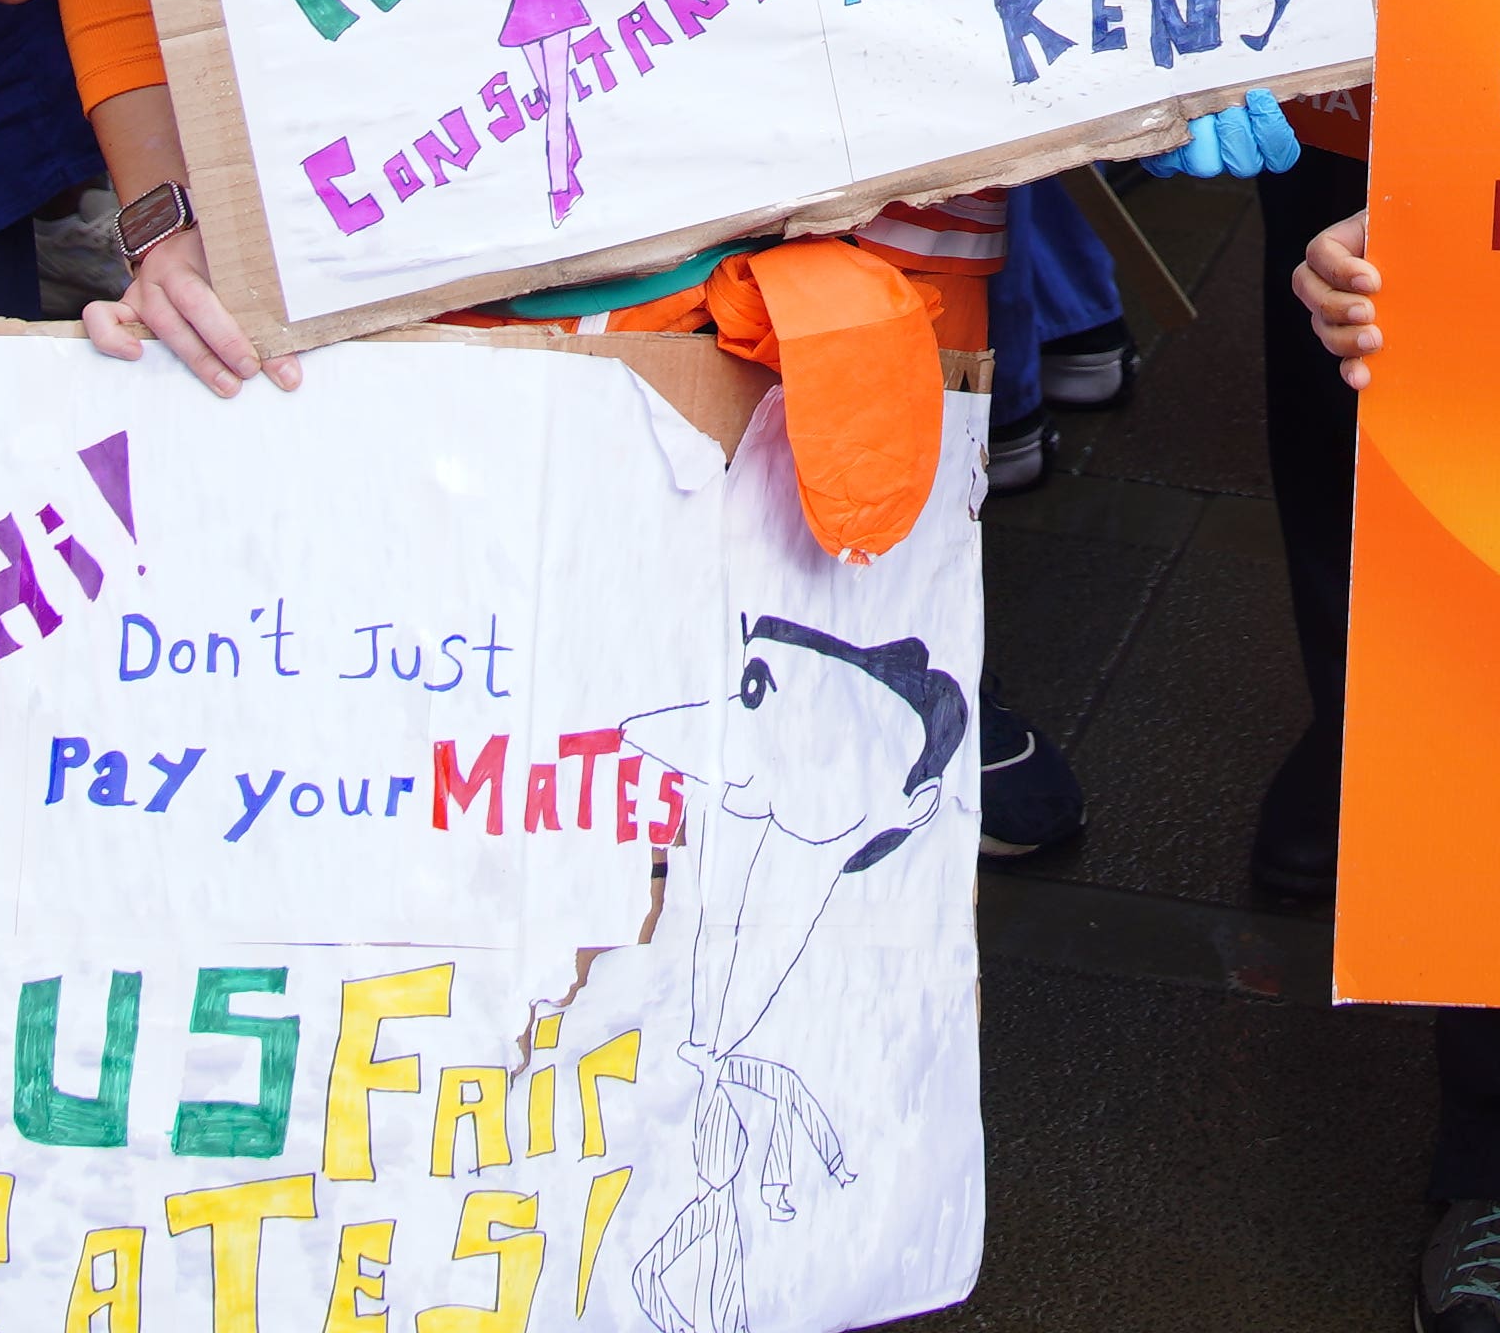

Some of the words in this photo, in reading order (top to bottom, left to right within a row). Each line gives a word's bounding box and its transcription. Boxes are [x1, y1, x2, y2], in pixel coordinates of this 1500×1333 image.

[118, 600, 303, 683] Don't
[233, 767, 414, 844] your
[12, 967, 302, 1159] US
